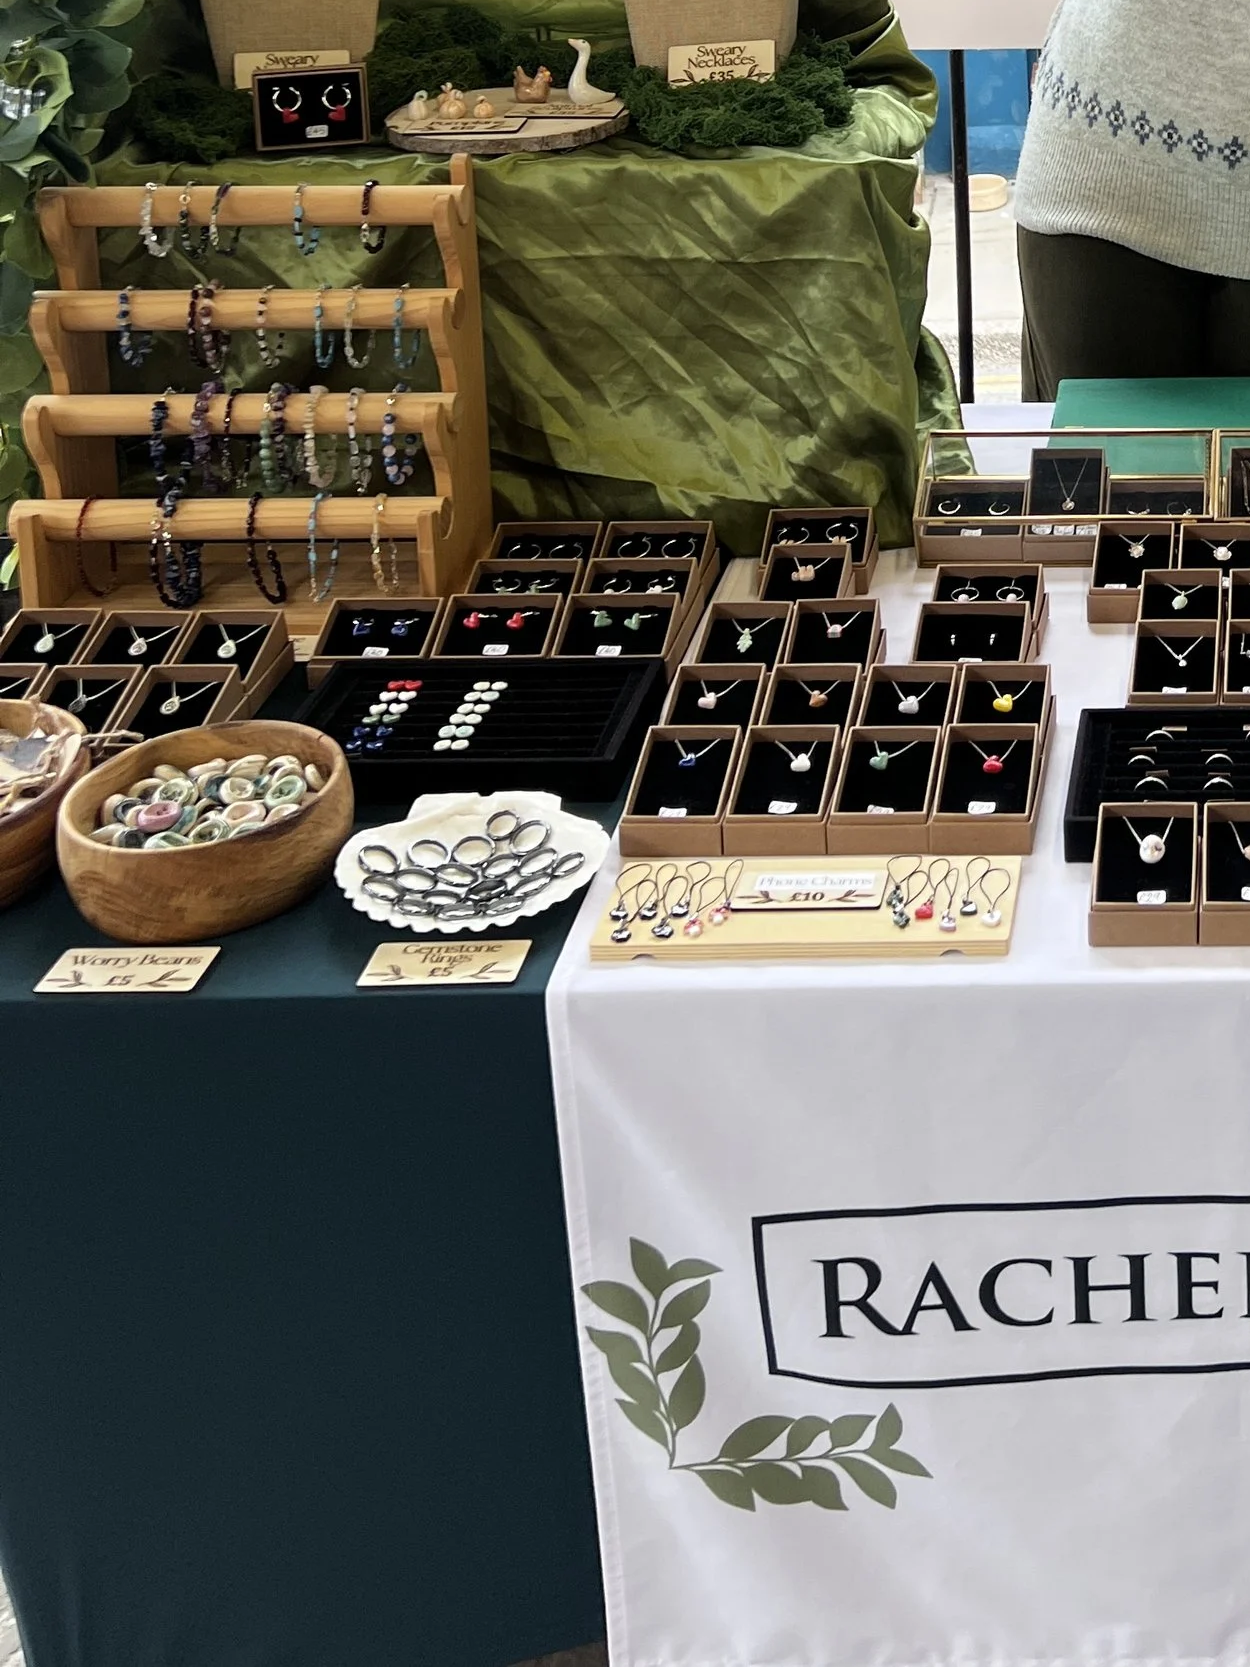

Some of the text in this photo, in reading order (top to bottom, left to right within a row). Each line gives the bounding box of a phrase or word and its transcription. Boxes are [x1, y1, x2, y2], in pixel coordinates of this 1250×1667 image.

[697, 45, 747, 58] Sweary
[265, 53, 320, 67] Sweary
[687, 54, 756, 70] Necklaces
[811, 875, 873, 886] Charms
[790, 891, 825, 901] £10
[402, 944, 503, 954] Gemstone
[72, 954, 204, 968] Worry Beans
[420, 953, 473, 965] Rings
[428, 967, 453, 977] £5
[105, 974, 135, 986] £5
